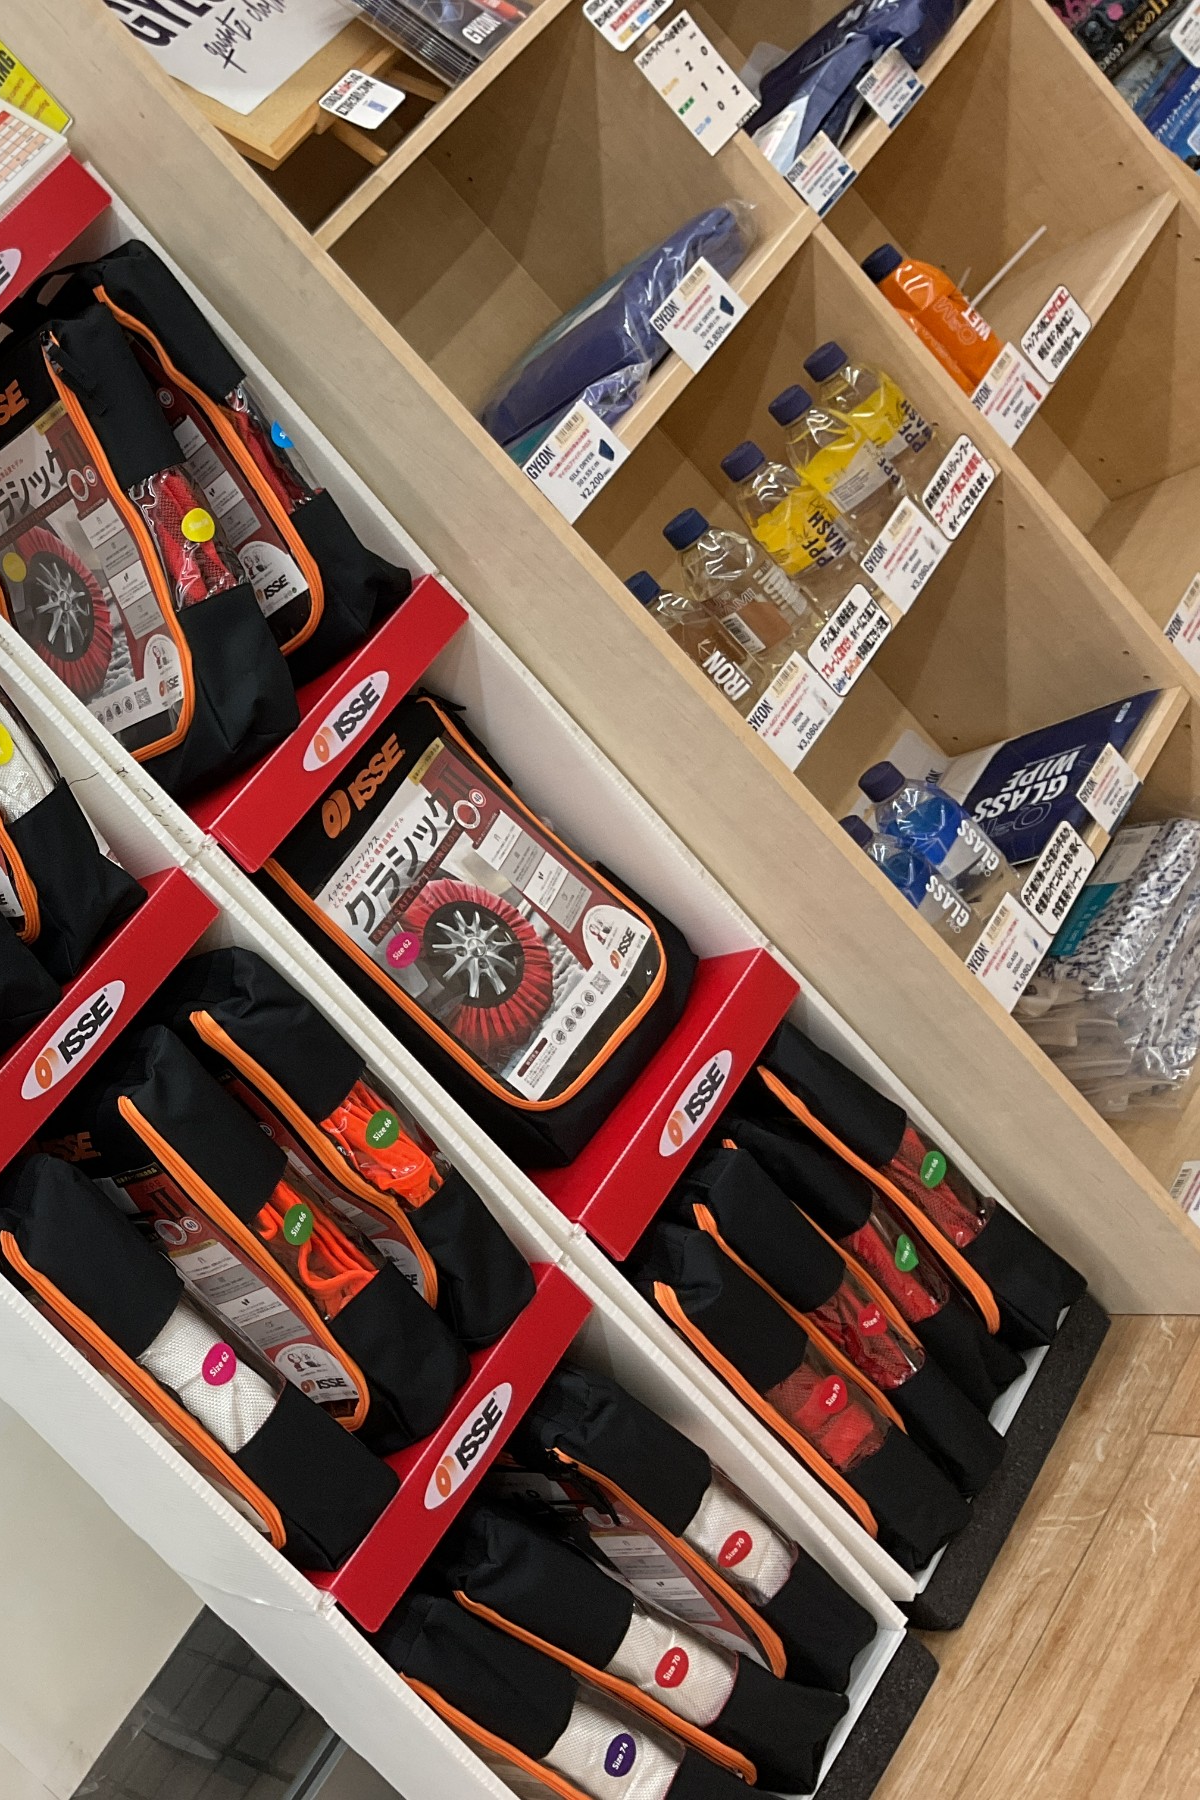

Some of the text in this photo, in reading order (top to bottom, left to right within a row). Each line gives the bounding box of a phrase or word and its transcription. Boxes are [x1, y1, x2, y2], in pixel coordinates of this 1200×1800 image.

[461, 10, 501, 44] GYEON
[683, 44, 709, 72] 2 0
[715, 84, 741, 111] 0 2
[653, 299, 680, 331] GYEON
[960, 307, 992, 342] WET
[703, 326, 725, 351] ¥3,850
[898, 422, 927, 453] PPF
[525, 444, 556, 479] GYEON
[568, 451, 595, 482] SILK DRYER
[585, 468, 593, 477] 55
[580, 472, 604, 500] ¥2,200
[807, 510, 848, 557] WASH
[801, 535, 834, 568] PPF
[863, 540, 888, 573] GYEON
[261, 574, 289, 599] ISSE
[702, 650, 750, 701] IRON
[333, 679, 378, 741] ISSE
[791, 711, 805, 726] IRON
[797, 722, 819, 750] ¥3,080
[342, 732, 407, 810] ISSE
[1001, 749, 1079, 792] WIPE
[973, 772, 1070, 823] GLASS
[1078, 776, 1097, 803] GYEON
[338, 785, 463, 935] クラシック
[956, 820, 1000, 871] GLASS
[324, 834, 380, 902] イッセ・スノーソックス
[330, 815, 405, 909] どんな雪道でも安心 標準品質モデル
[925, 875, 971, 928] GLASS
[391, 938, 412, 960] Size 62
[614, 926, 638, 957] ISSE
[1013, 964, 1032, 992] ¥1,980
[58, 994, 112, 1064] ISSE
[683, 1061, 725, 1126] ISSE
[372, 1117, 393, 1142] Size 66
[923, 1157, 941, 1181] Size 66
[289, 1211, 307, 1236] Size 66
[862, 1316, 878, 1329] Size
[208, 1351, 230, 1377] Size 62
[317, 1377, 348, 1391] ISSE
[823, 1382, 841, 1406] Size 70
[454, 1397, 504, 1471] ISSE
[723, 1536, 746, 1561] Size 70
[661, 1653, 682, 1681] Size 70
[610, 1741, 630, 1770] Size 74
